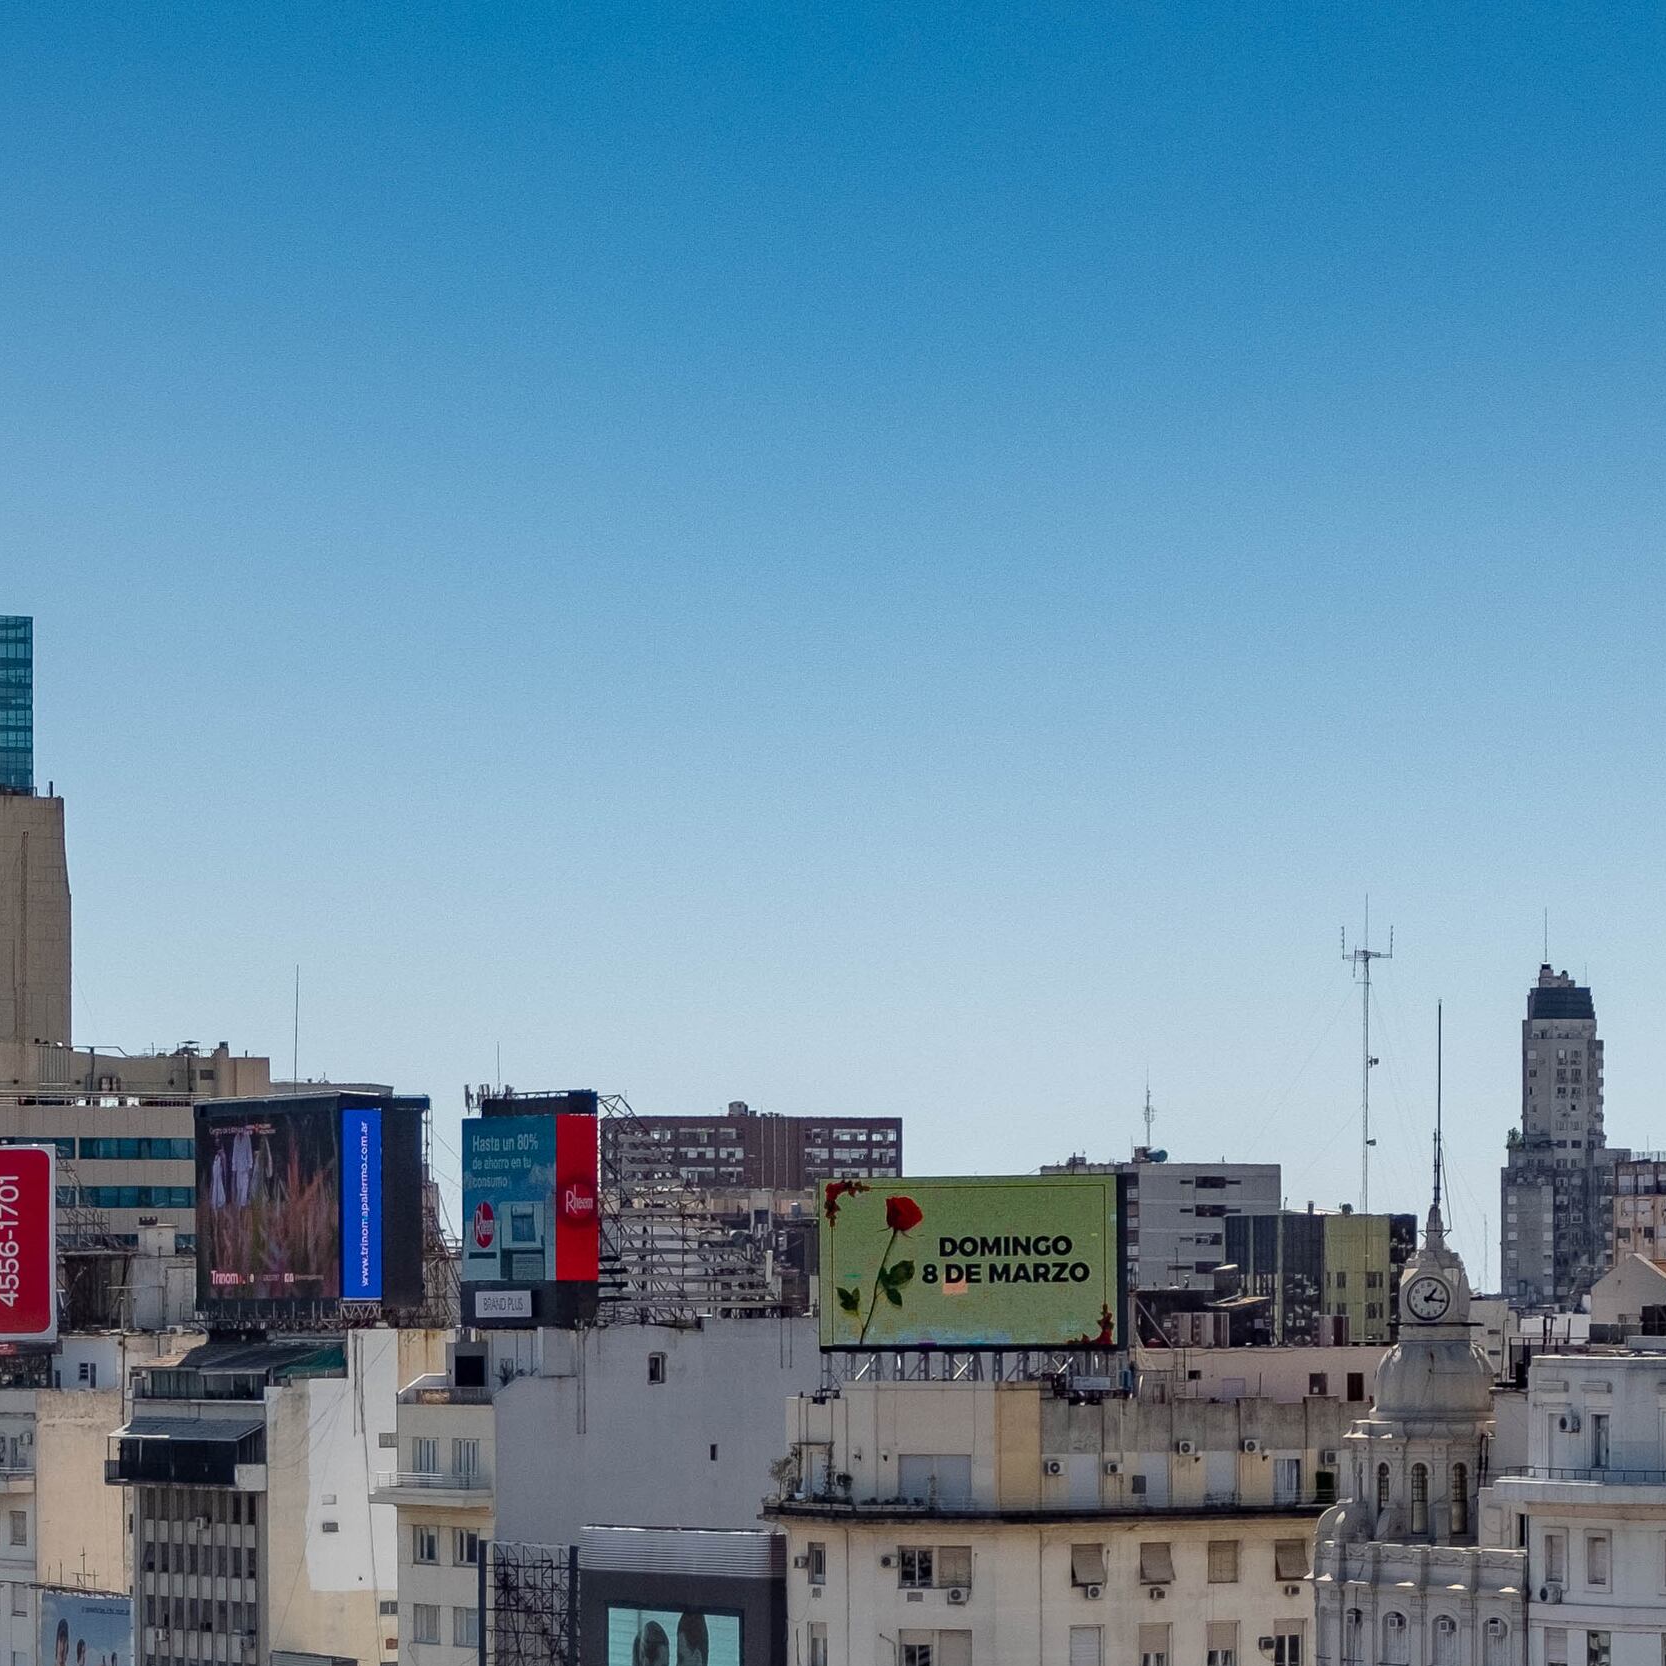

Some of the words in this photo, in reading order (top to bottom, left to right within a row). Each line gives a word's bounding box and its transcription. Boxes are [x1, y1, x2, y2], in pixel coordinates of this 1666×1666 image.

[473, 1135, 500, 1152] Hasta
[502, 1136, 514, 1151] un
[517, 1133, 539, 1151] 80%
[939, 1235, 1073, 1257] DOMINGO
[922, 1264, 938, 1284] 8
[944, 1264, 982, 1284] DE
[988, 1262, 1090, 1283] MARZO
